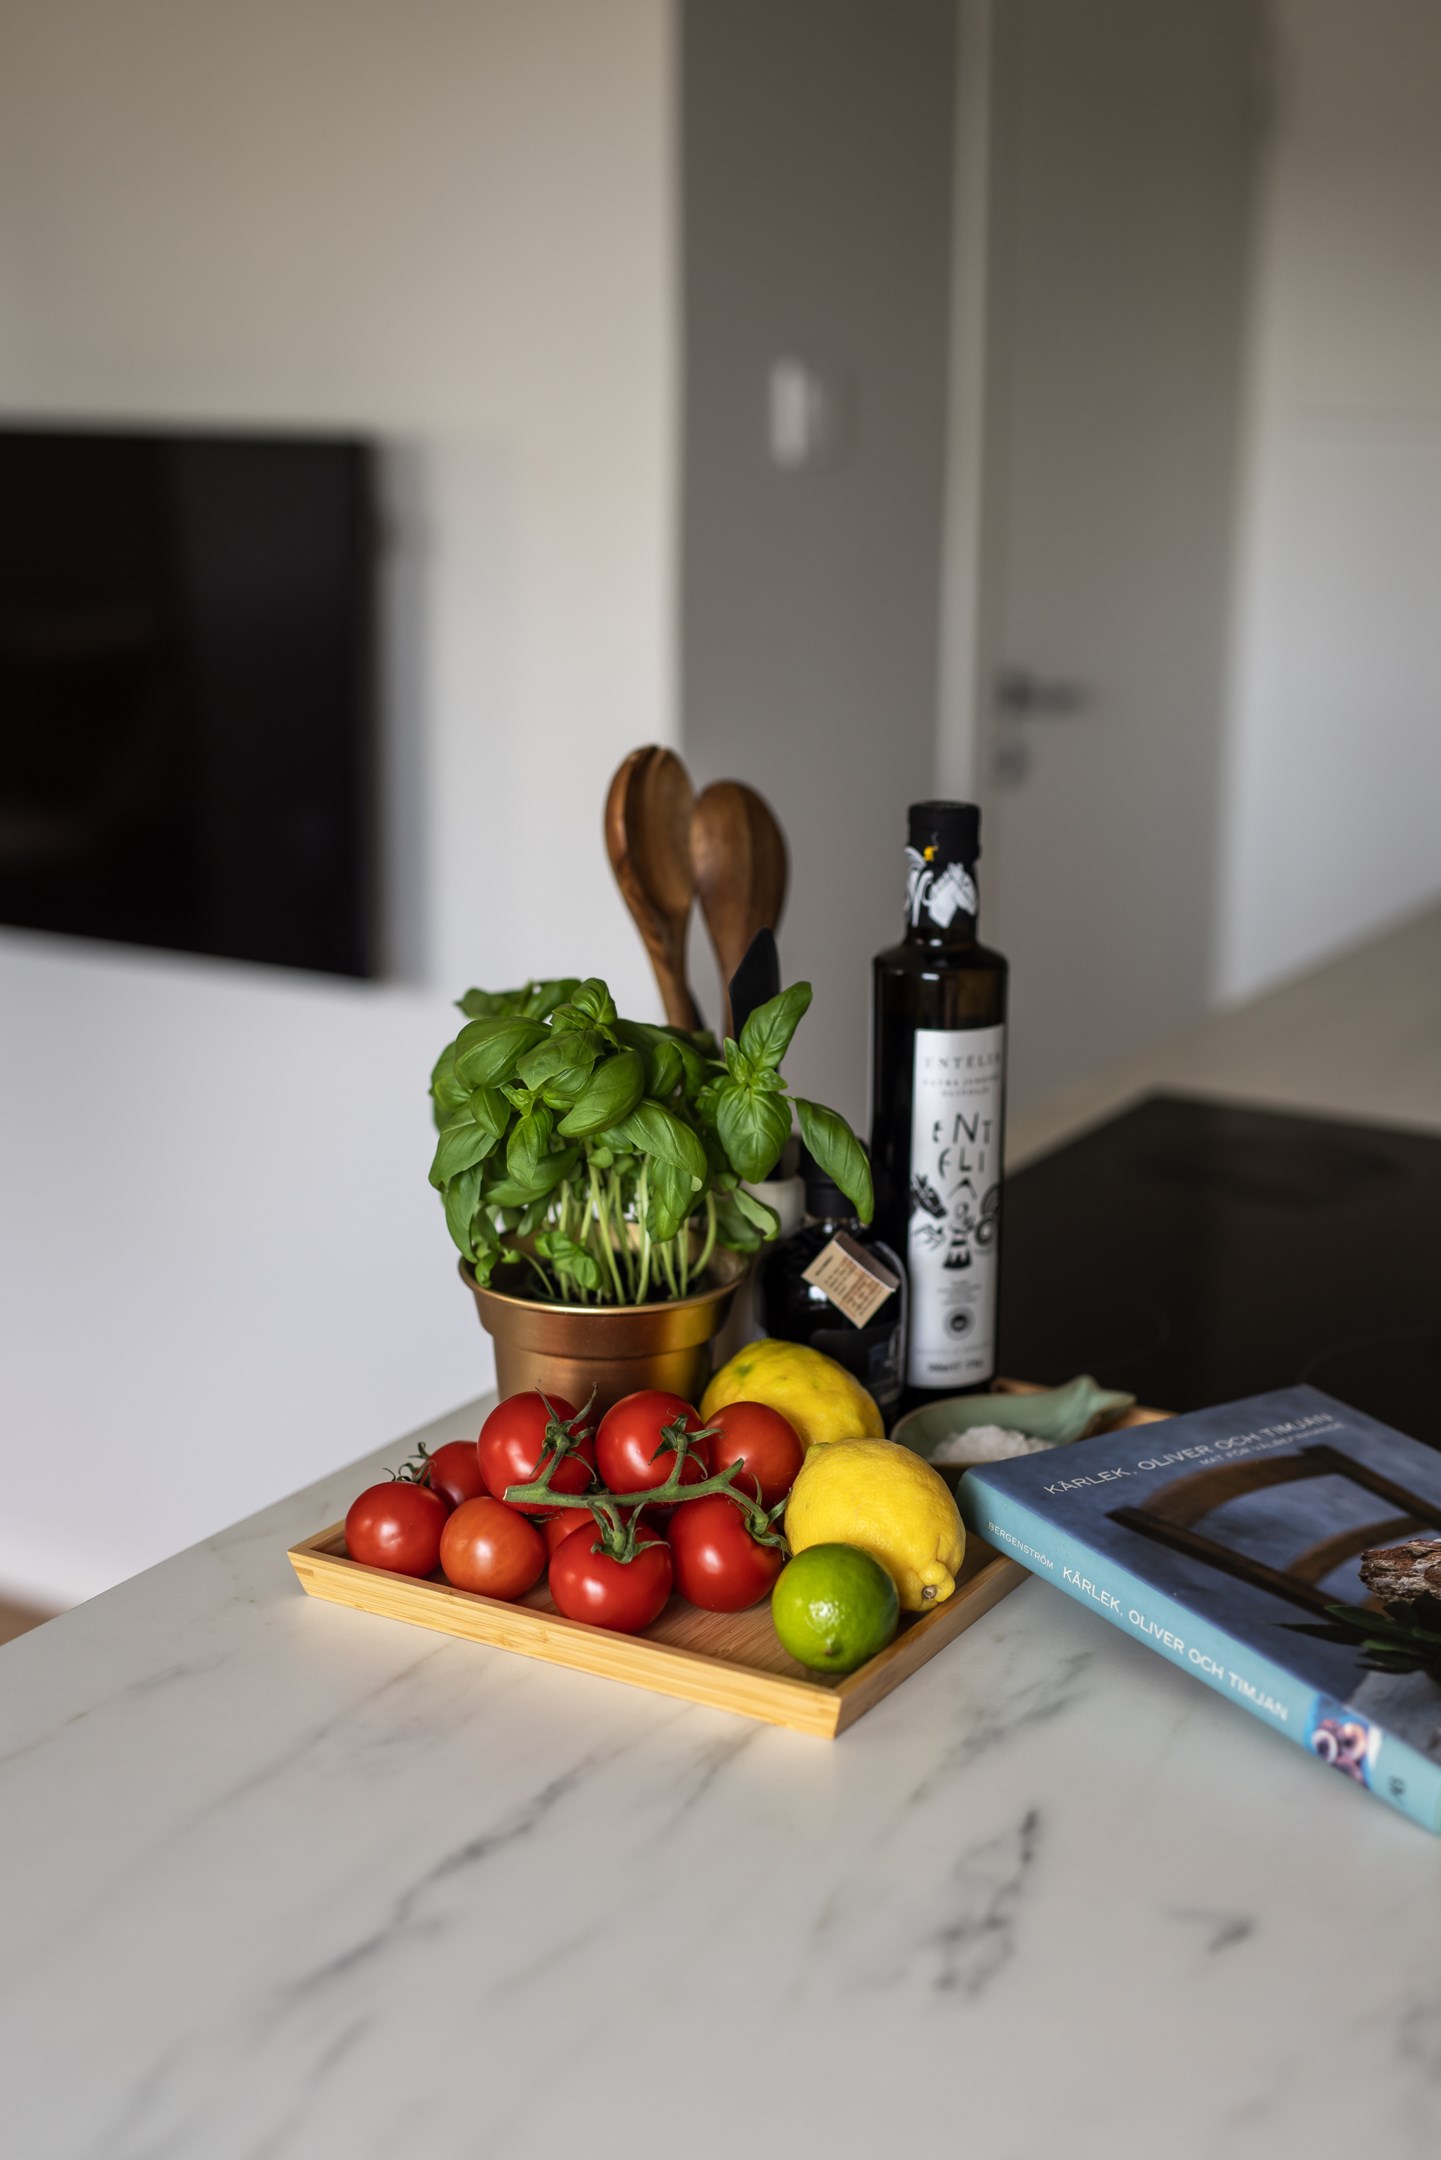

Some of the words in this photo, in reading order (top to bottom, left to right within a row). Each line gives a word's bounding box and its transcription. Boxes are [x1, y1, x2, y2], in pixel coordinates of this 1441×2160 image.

[1137, 1444, 1213, 1471] OLIVER
[1214, 1431, 1262, 1450] OCH
[1258, 1411, 1334, 1437] TIMJAN
[988, 1521, 1054, 1570] BERGENSTRÖM
[1128, 1609, 1185, 1655] OLIVER
[1188, 1648, 1225, 1681] OCH
[1228, 1671, 1289, 1721] TIMJAN
